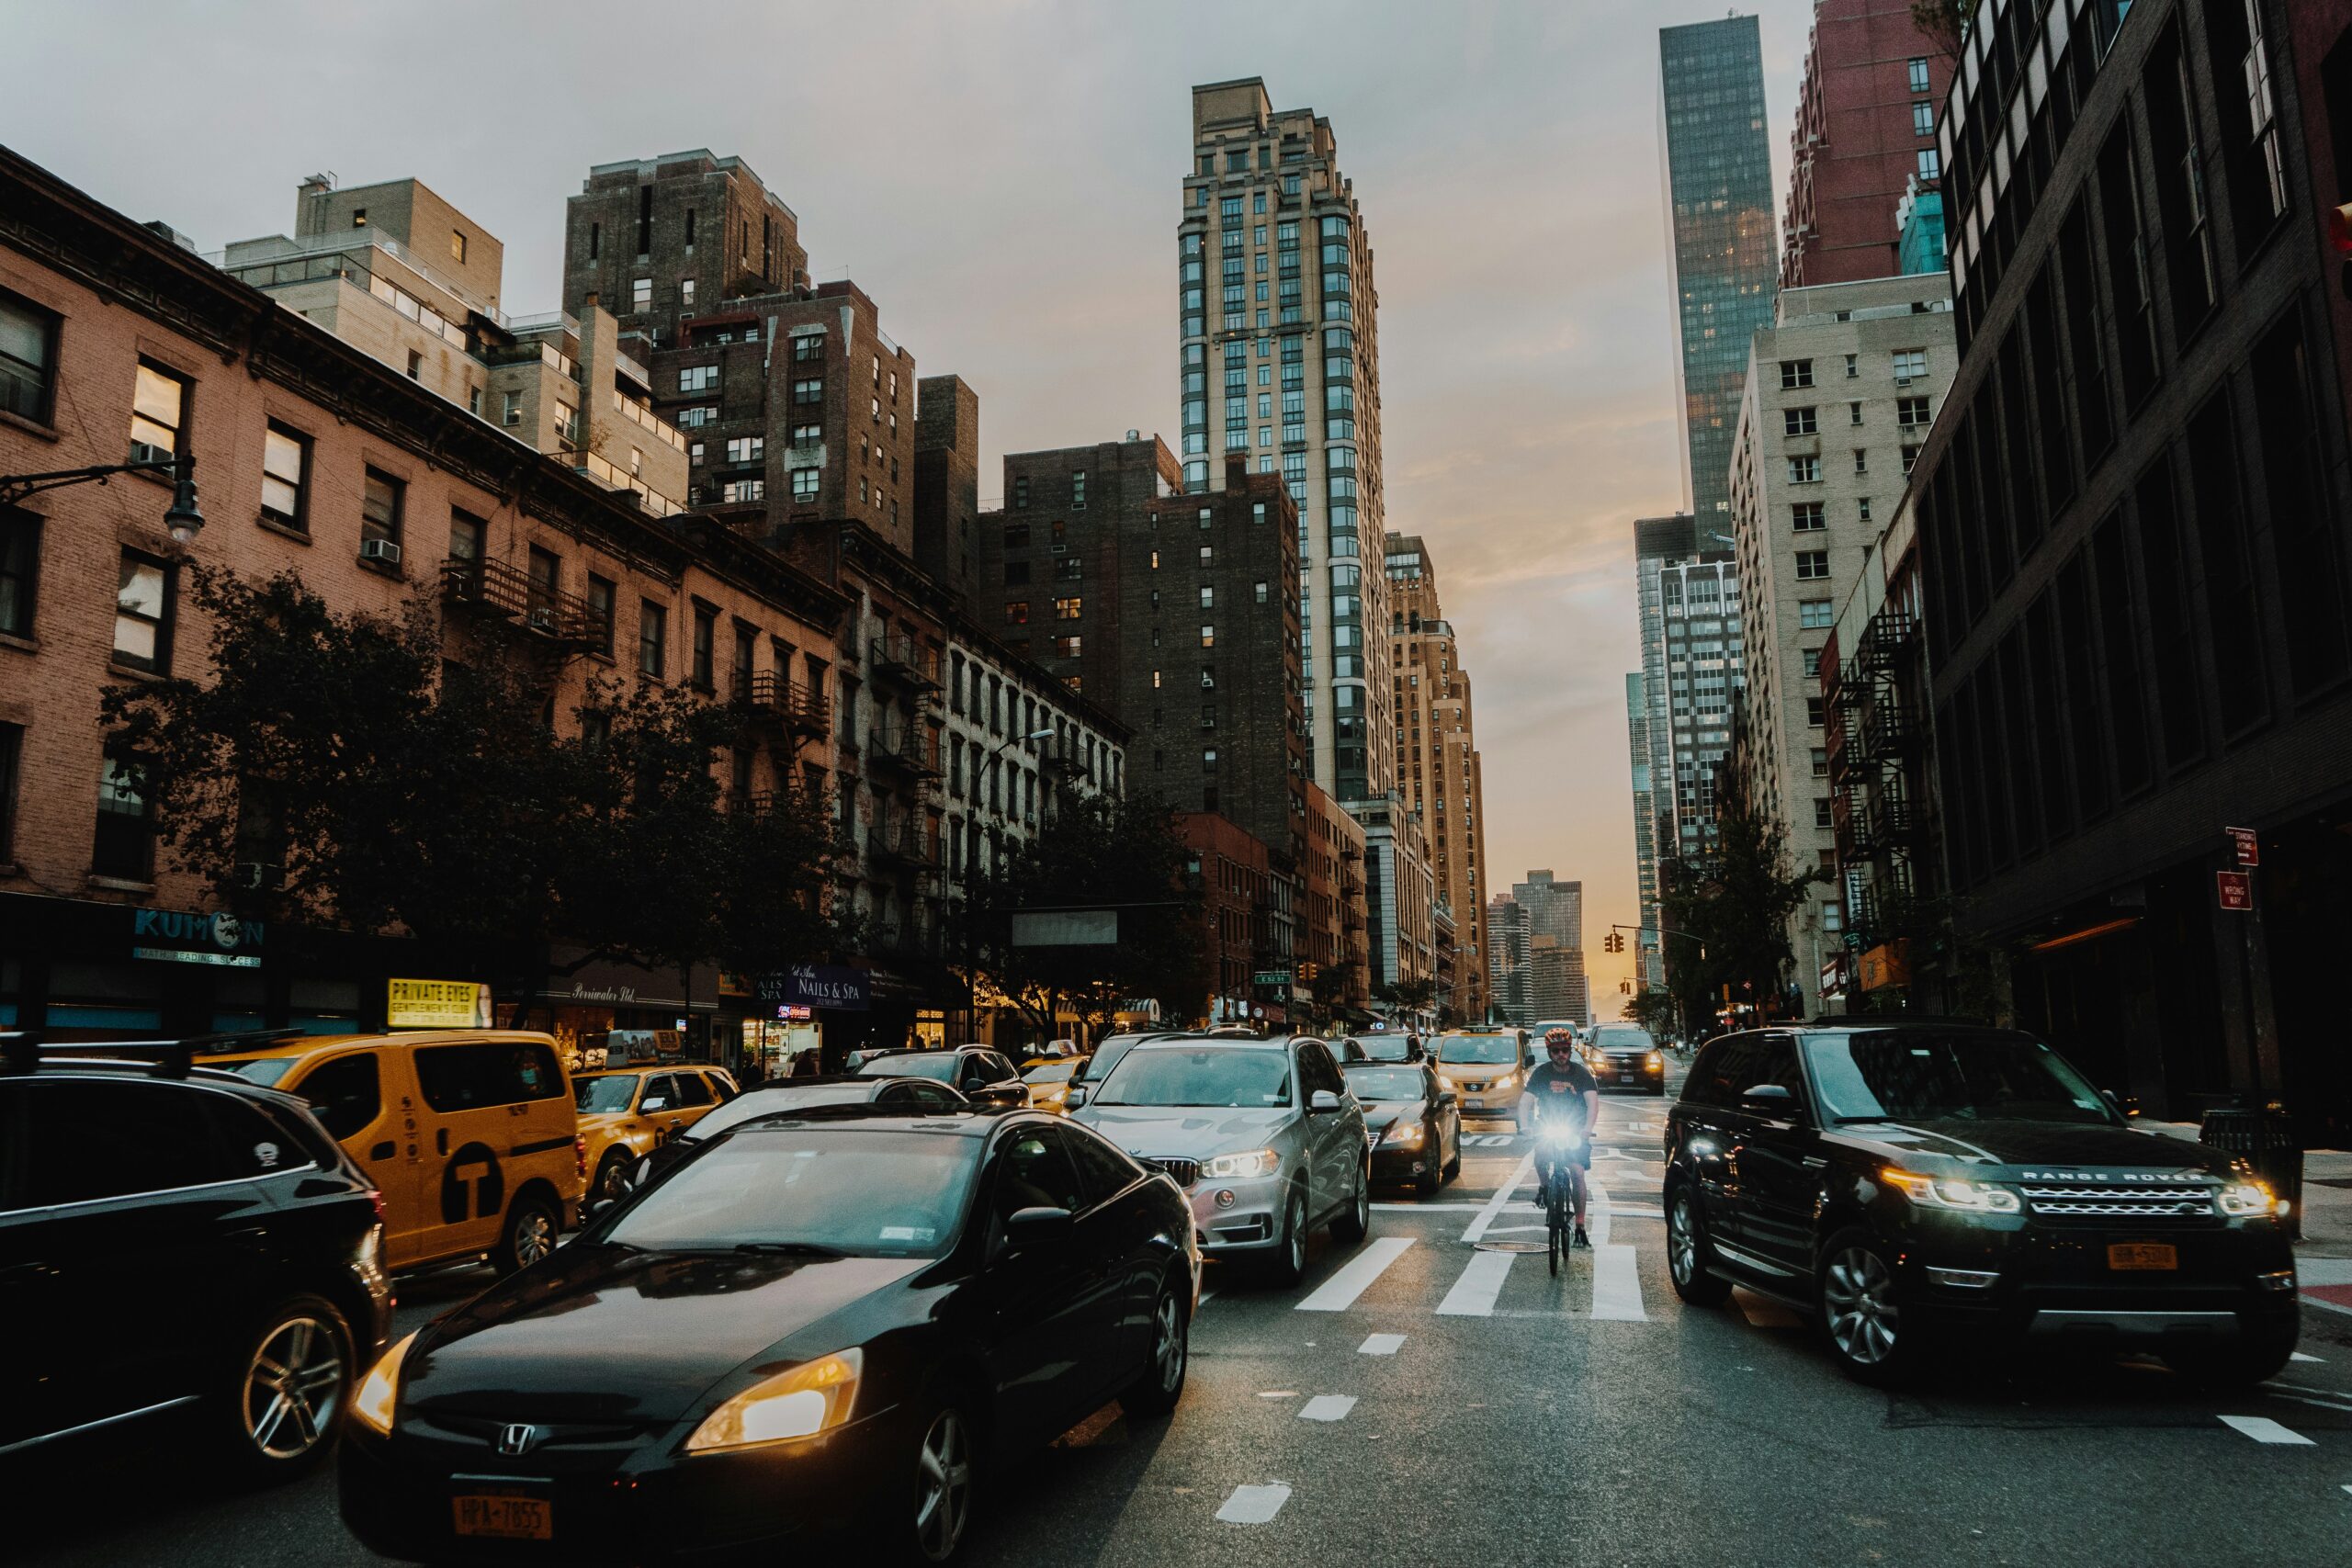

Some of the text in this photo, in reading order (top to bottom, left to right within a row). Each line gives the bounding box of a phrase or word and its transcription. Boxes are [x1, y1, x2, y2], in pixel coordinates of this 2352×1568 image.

[2224, 886, 2245, 895] WRONG
[2229, 896, 2241, 904] WAY
[134, 908, 264, 948] KUMON
[392, 982, 470, 1002] PRIVATE EYES
[798, 978, 860, 1000] NAILS & SPA
[452, 1004, 470, 1014] CLUB
[2022, 1171, 2204, 1182] RANGE ROVER
[456, 1160, 491, 1225] T
